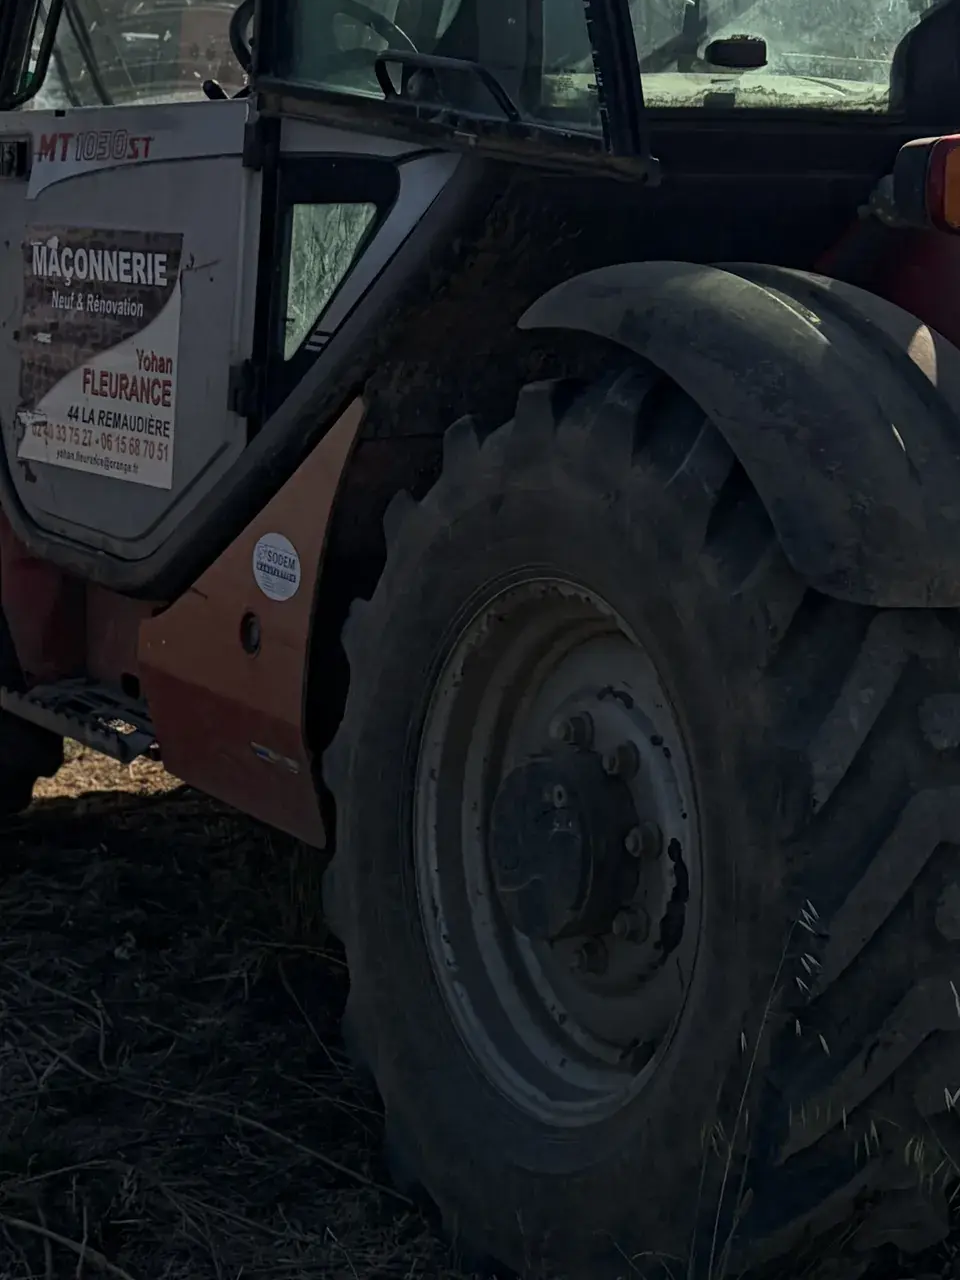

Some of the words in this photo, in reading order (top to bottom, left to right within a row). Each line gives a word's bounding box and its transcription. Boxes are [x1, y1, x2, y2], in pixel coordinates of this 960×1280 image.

[32, 245, 167, 286] MAÇONNERIE
[52, 290, 74, 309] Neuf
[76, 293, 83, 310] &
[87, 293, 143, 317] Rénovation
[136, 348, 173, 374] Yohan
[83, 368, 172, 407] FLEURANCE
[67, 405, 79, 422] 44
[82, 407, 95, 425] LA
[98, 410, 170, 438] REMAUDIÈRE
[56, 424, 66, 442] 33
[68, 426, 80, 445] 75
[82, 429, 93, 447] 27
[100, 433, 112, 451] 06
[115, 435, 126, 454] 15
[129, 437, 140, 457] 68
[143, 440, 155, 460] 70
[157, 442, 169, 462] 51
[267, 549, 296, 570] SODEM
